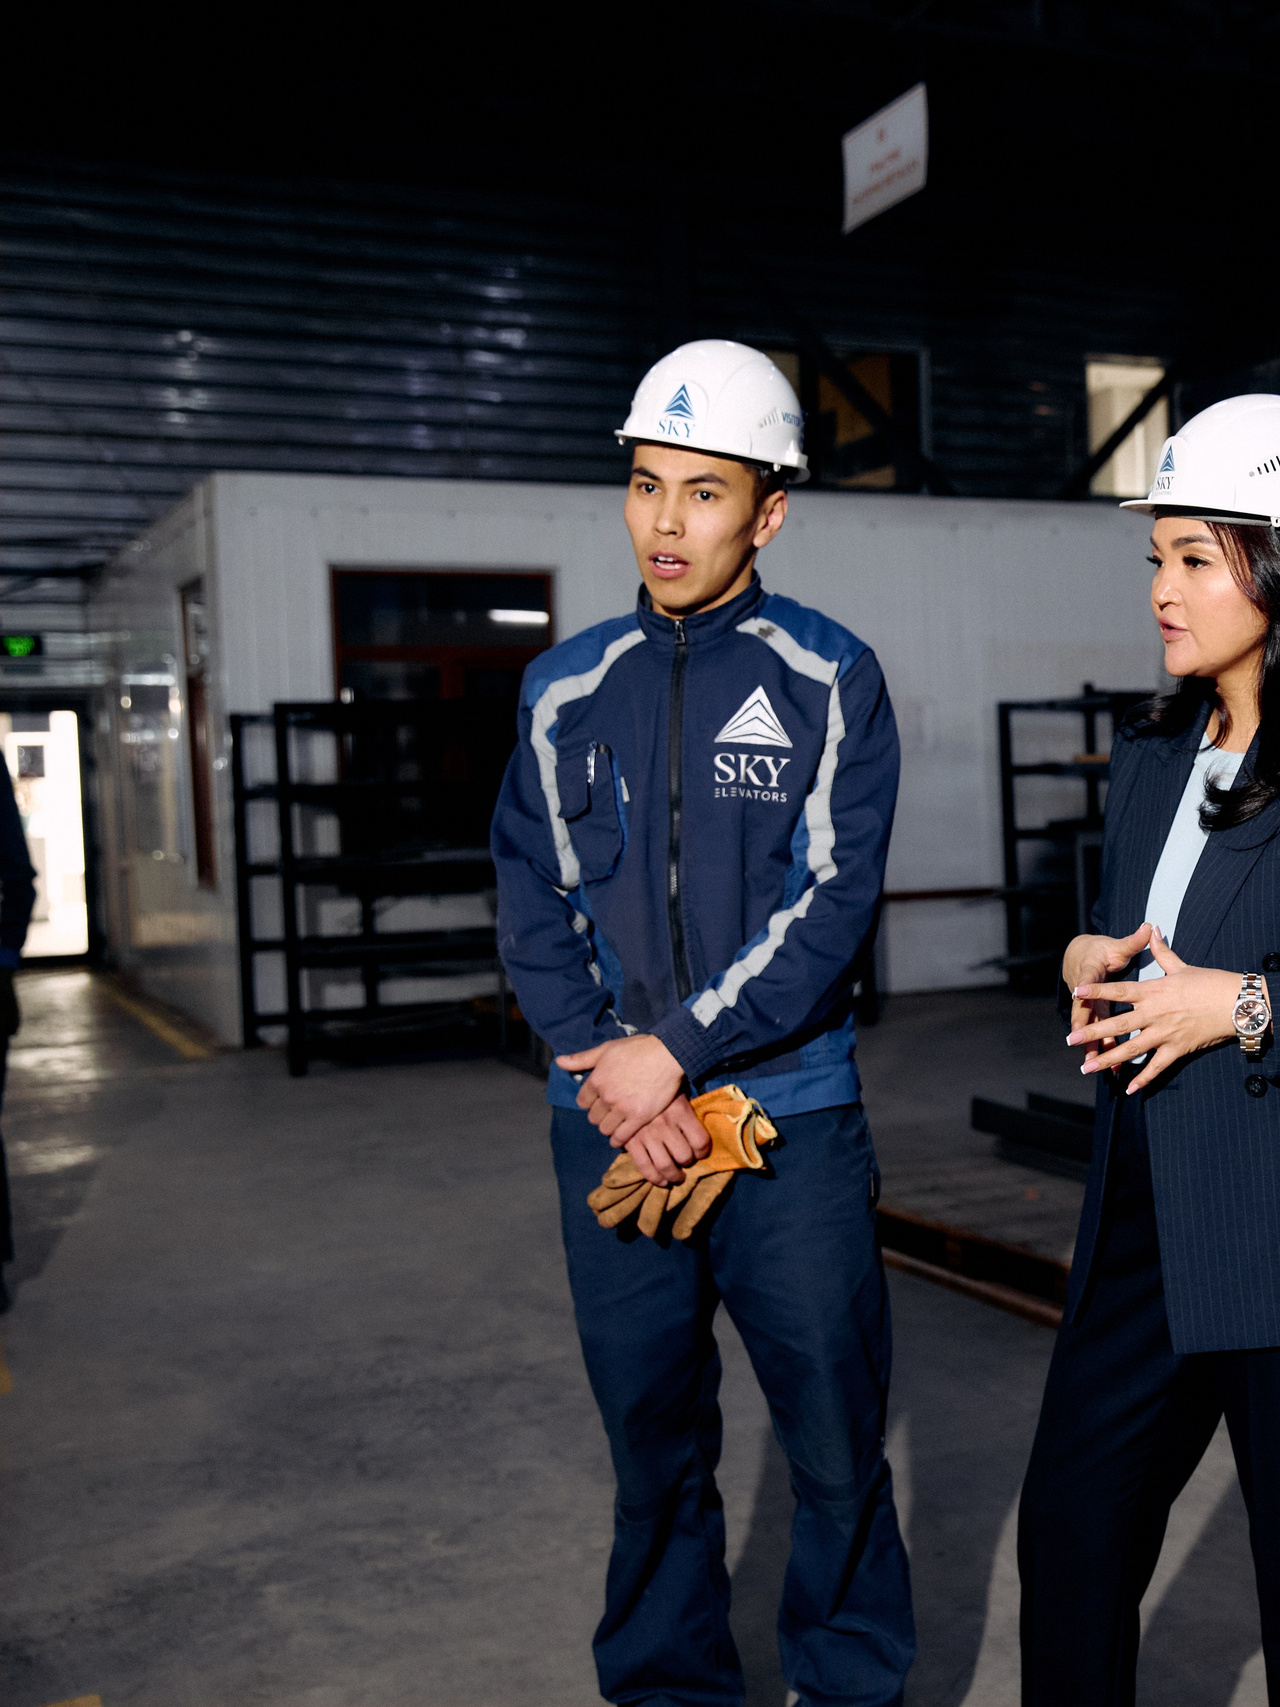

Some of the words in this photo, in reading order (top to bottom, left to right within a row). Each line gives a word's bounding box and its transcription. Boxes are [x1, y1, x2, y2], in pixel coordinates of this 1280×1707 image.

[656, 419, 697, 438] SKY
[1156, 476, 1174, 490] SKY
[714, 752, 791, 787] SKY
[714, 787, 788, 802] ELEVATORS
